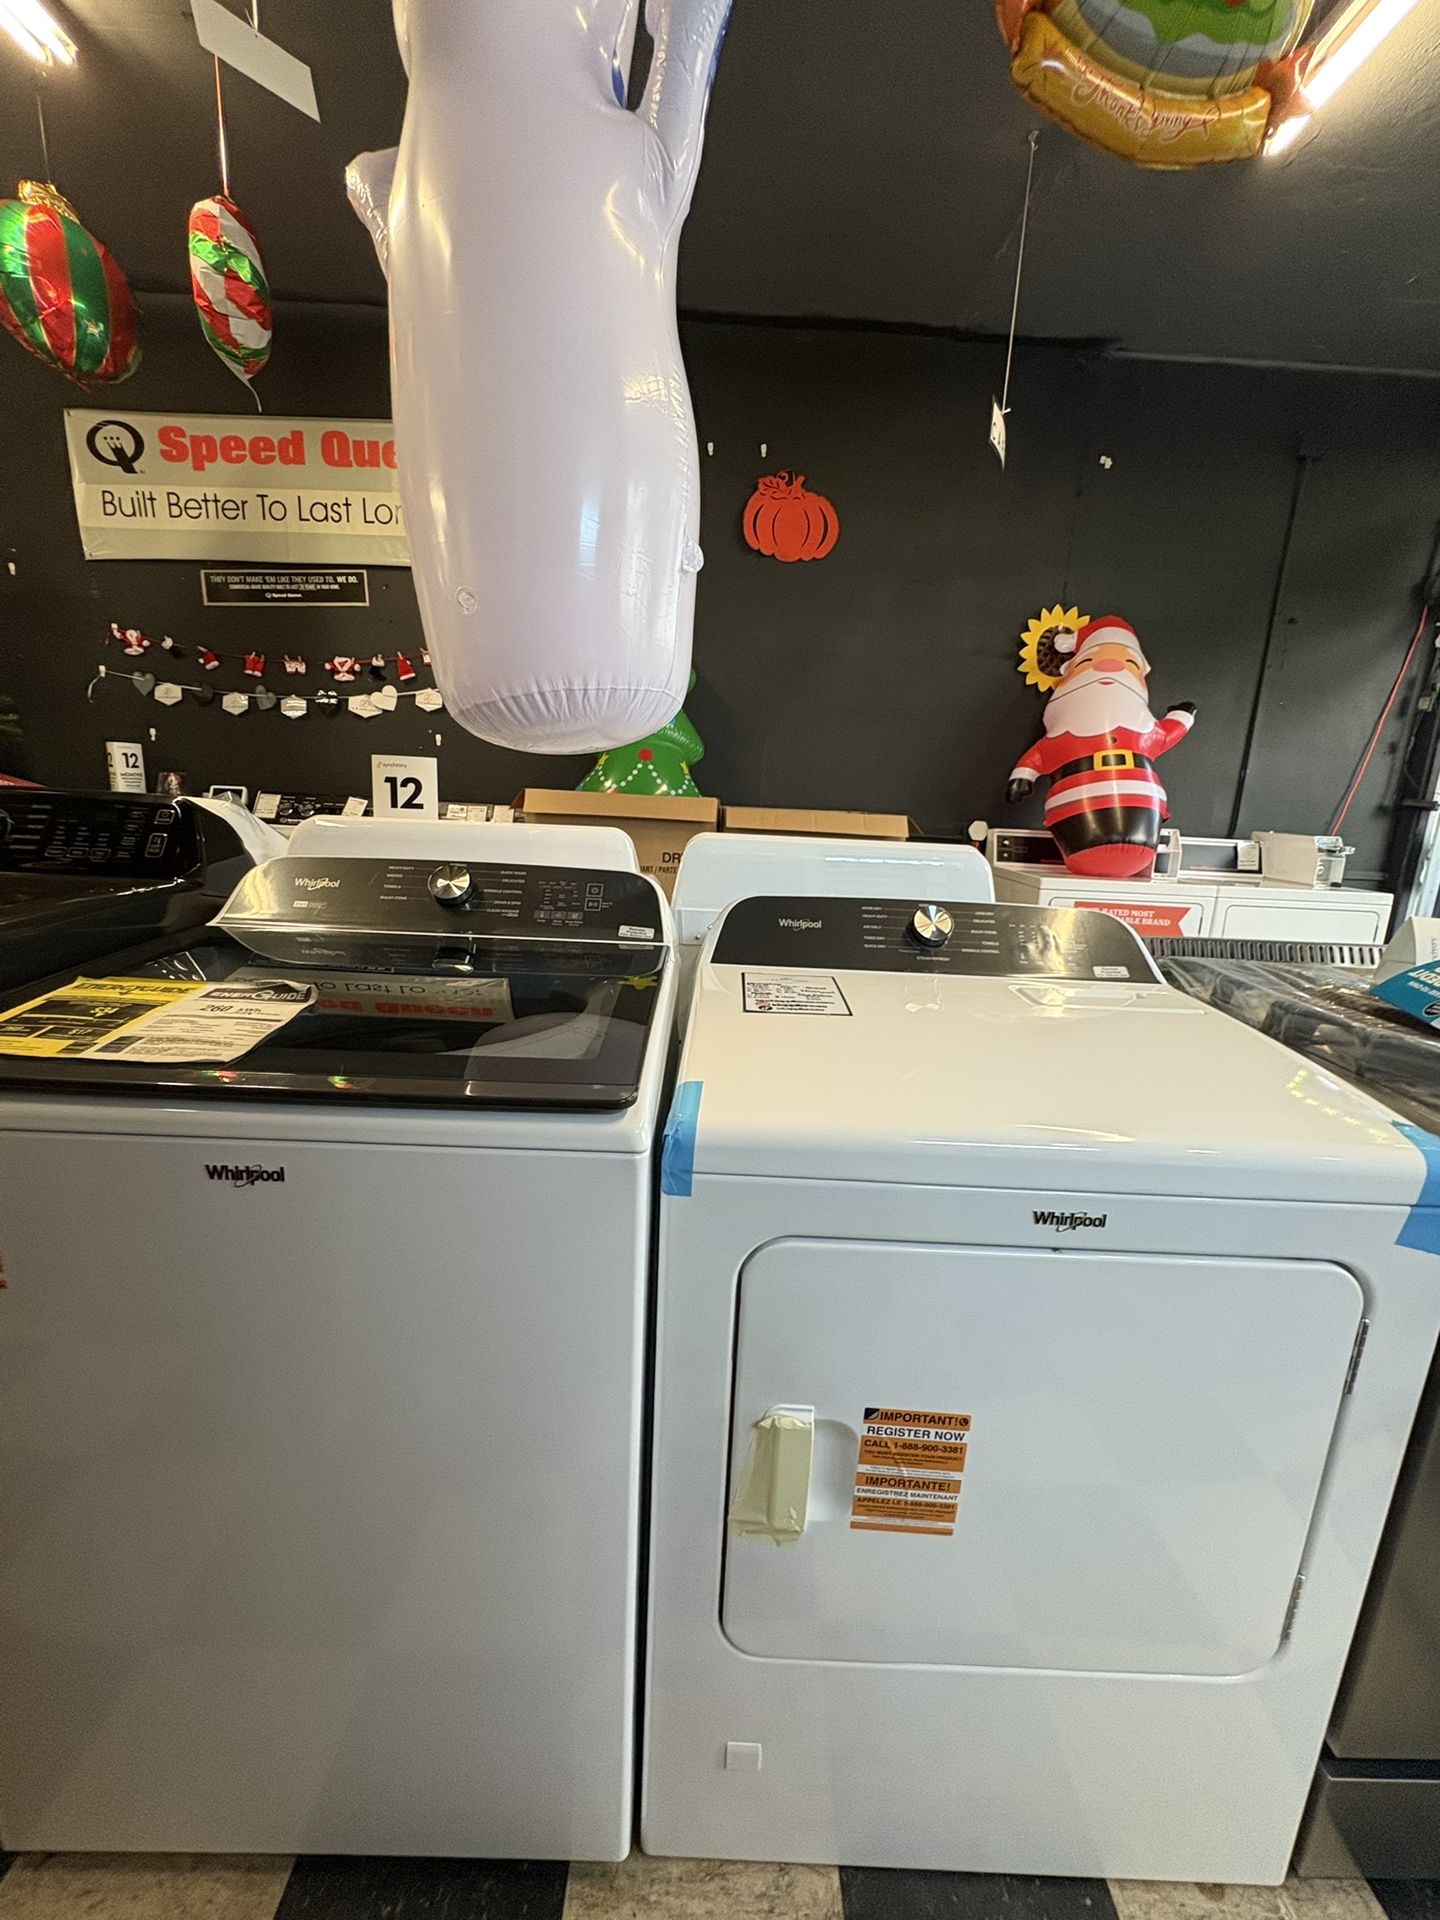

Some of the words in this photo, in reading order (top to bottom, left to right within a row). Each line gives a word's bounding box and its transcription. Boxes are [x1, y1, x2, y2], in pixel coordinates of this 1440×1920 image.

[157, 425, 306, 471] Speed
[101, 489, 157, 518] Built
[166, 491, 248, 520] Better
[256, 494, 287, 522] To
[298, 495, 352, 523] Last
[121, 752, 140, 768] 12
[384, 776, 424, 809] 12
[662, 852, 682, 864] DR
[294, 877, 341, 891] Whirlpool
[1131, 910, 1156, 918] MOST
[778, 918, 822, 931] Whirlpool
[1142, 919, 1172, 927] BRAND
[199, 1004, 231, 1013] 260
[205, 1164, 285, 1188] Whirlpool
[1033, 1210, 1107, 1232] Whirlpool
[880, 1411, 958, 1426] IMPORTANT!
[867, 1426, 931, 1439] REGISTER
[934, 1431, 965, 1441] NOW
[864, 1439, 890, 1449] CALL
[894, 1442, 963, 1454] 1-888-900-3381
[865, 1476, 951, 1491] IMPORTANTE!
[857, 1488, 908, 1497] ENREGISTREZ
[910, 1492, 958, 1501] MAINTENANT
